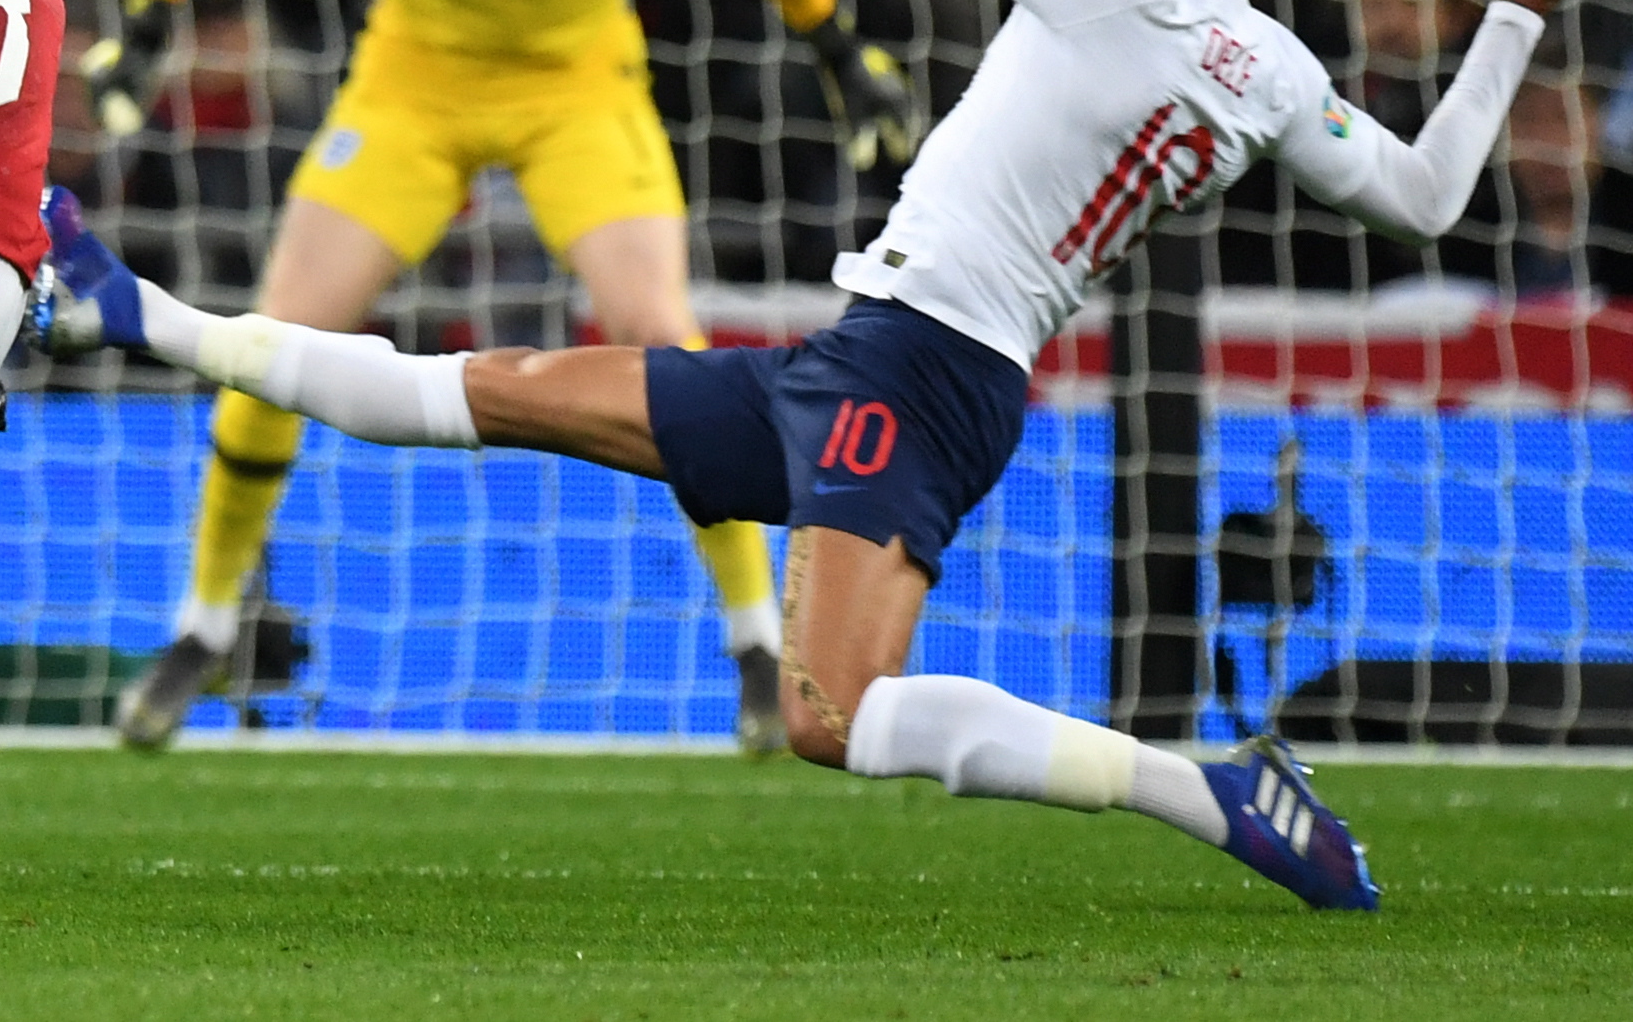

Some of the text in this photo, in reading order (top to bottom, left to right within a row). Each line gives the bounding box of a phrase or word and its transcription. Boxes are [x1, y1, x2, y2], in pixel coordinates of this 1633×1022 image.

[1200, 27, 1258, 98] DELE
[1051, 102, 1216, 274] 10
[818, 398, 899, 476] 10
